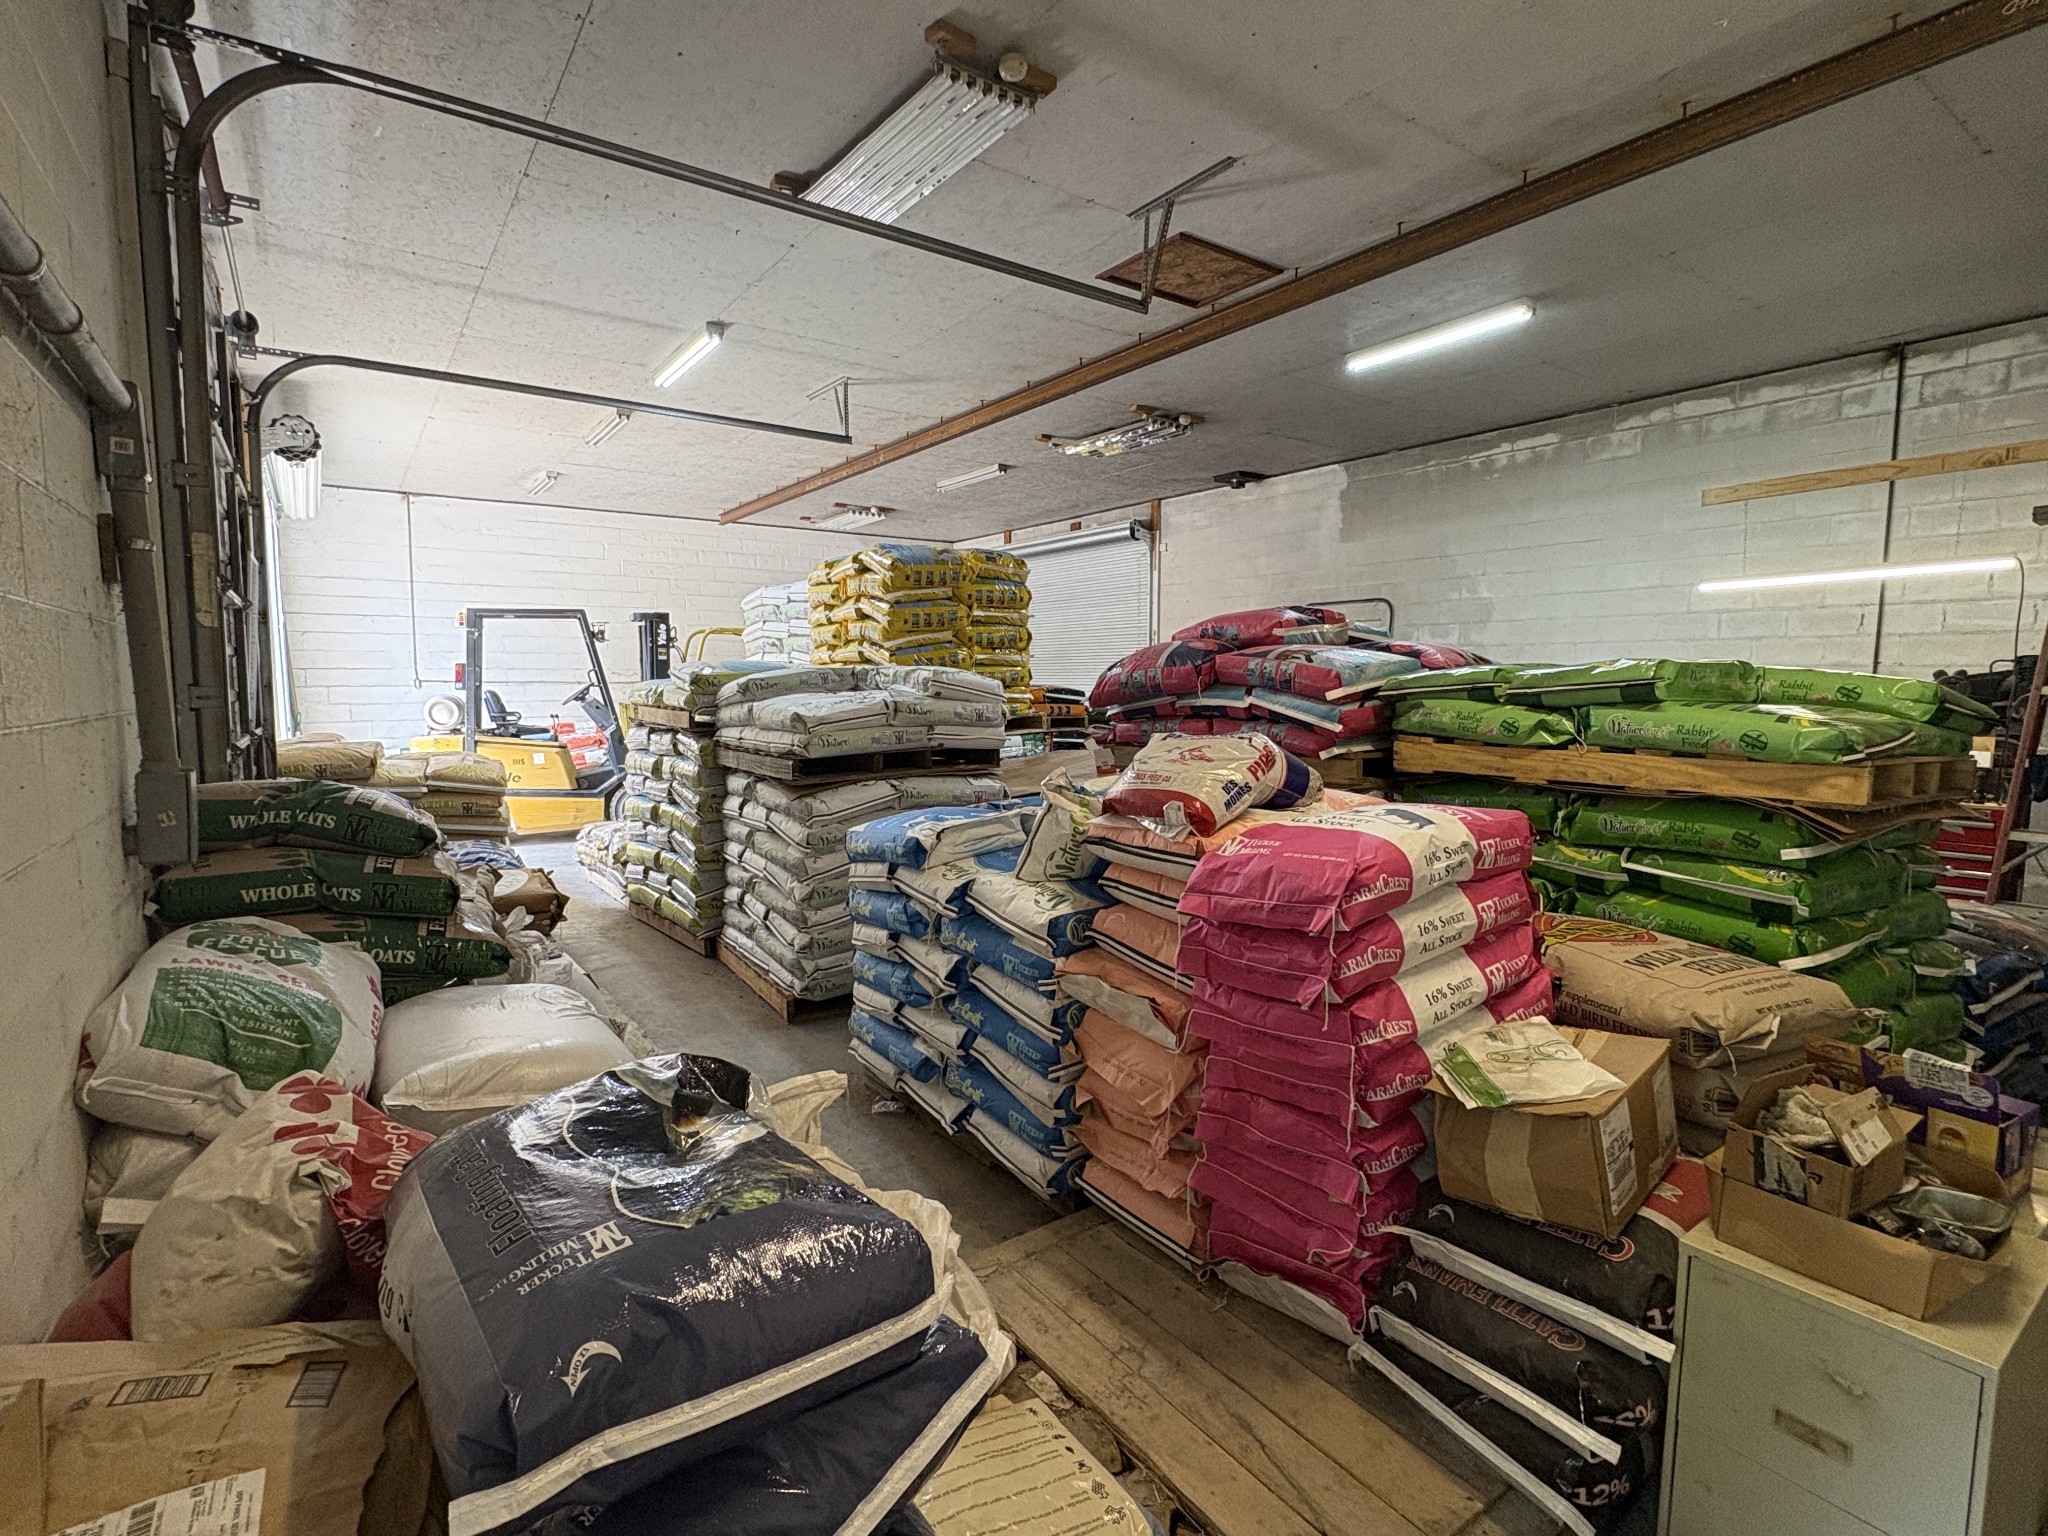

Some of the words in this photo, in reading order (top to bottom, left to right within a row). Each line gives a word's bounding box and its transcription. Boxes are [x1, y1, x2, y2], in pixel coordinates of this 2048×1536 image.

[1778, 679, 1814, 691] Rabbit
[1780, 690, 1808, 701] Feed
[1455, 709, 1485, 724] Rabbit
[1456, 722, 1479, 735] Feed
[1676, 725, 1714, 738] Rabbit
[1681, 736, 1710, 750] Feed
[1221, 779, 1239, 796] DES
[1223, 781, 1253, 812] MOINES
[229, 811, 291, 829] WHOLE
[1668, 821, 1706, 836] Rabbit
[1495, 837, 1521, 853] TUCKER
[1673, 834, 1702, 848] Feed
[1424, 851, 1442, 868] 16%
[1428, 871, 1445, 887] ALL
[240, 883, 317, 904] WHOLE
[1493, 892, 1520, 912] TUCKER
[1417, 921, 1439, 937] 16%
[1439, 911, 1466, 928] SWEET
[1665, 918, 1704, 937] Rabbit
[228, 935, 283, 948] TALL
[1419, 942, 1436, 955] ALL
[1438, 931, 1464, 948] STOCK
[171, 957, 242, 972] LAWN
[370, 949, 417, 964] OATS
[1502, 954, 1529, 976] TUCKER
[1623, 947, 1685, 972] WILD
[1424, 987, 1448, 1007] 16%
[1447, 977, 1474, 997] SWEET
[1432, 1009, 1449, 1025] ALL
[1450, 995, 1475, 1015] STOCK
[1517, 999, 1548, 1021] TUCKER
[1554, 1000, 1580, 1017] ILD
[1581, 1007, 1610, 1028] BIRD
[1565, 990, 1623, 1017] supplemental
[230, 1015, 298, 1039] RESISTANT
[1353, 1018, 1414, 1047] ARMCREST
[1362, 1145, 1425, 1175] ARMCREST
[466, 1162, 535, 1258] Floating
[508, 1235, 588, 1282] MILLING
[516, 1250, 594, 1296] TUCKER
[570, 1357, 585, 1388] OPEN
[1571, 1465, 1632, 1507] 12%
